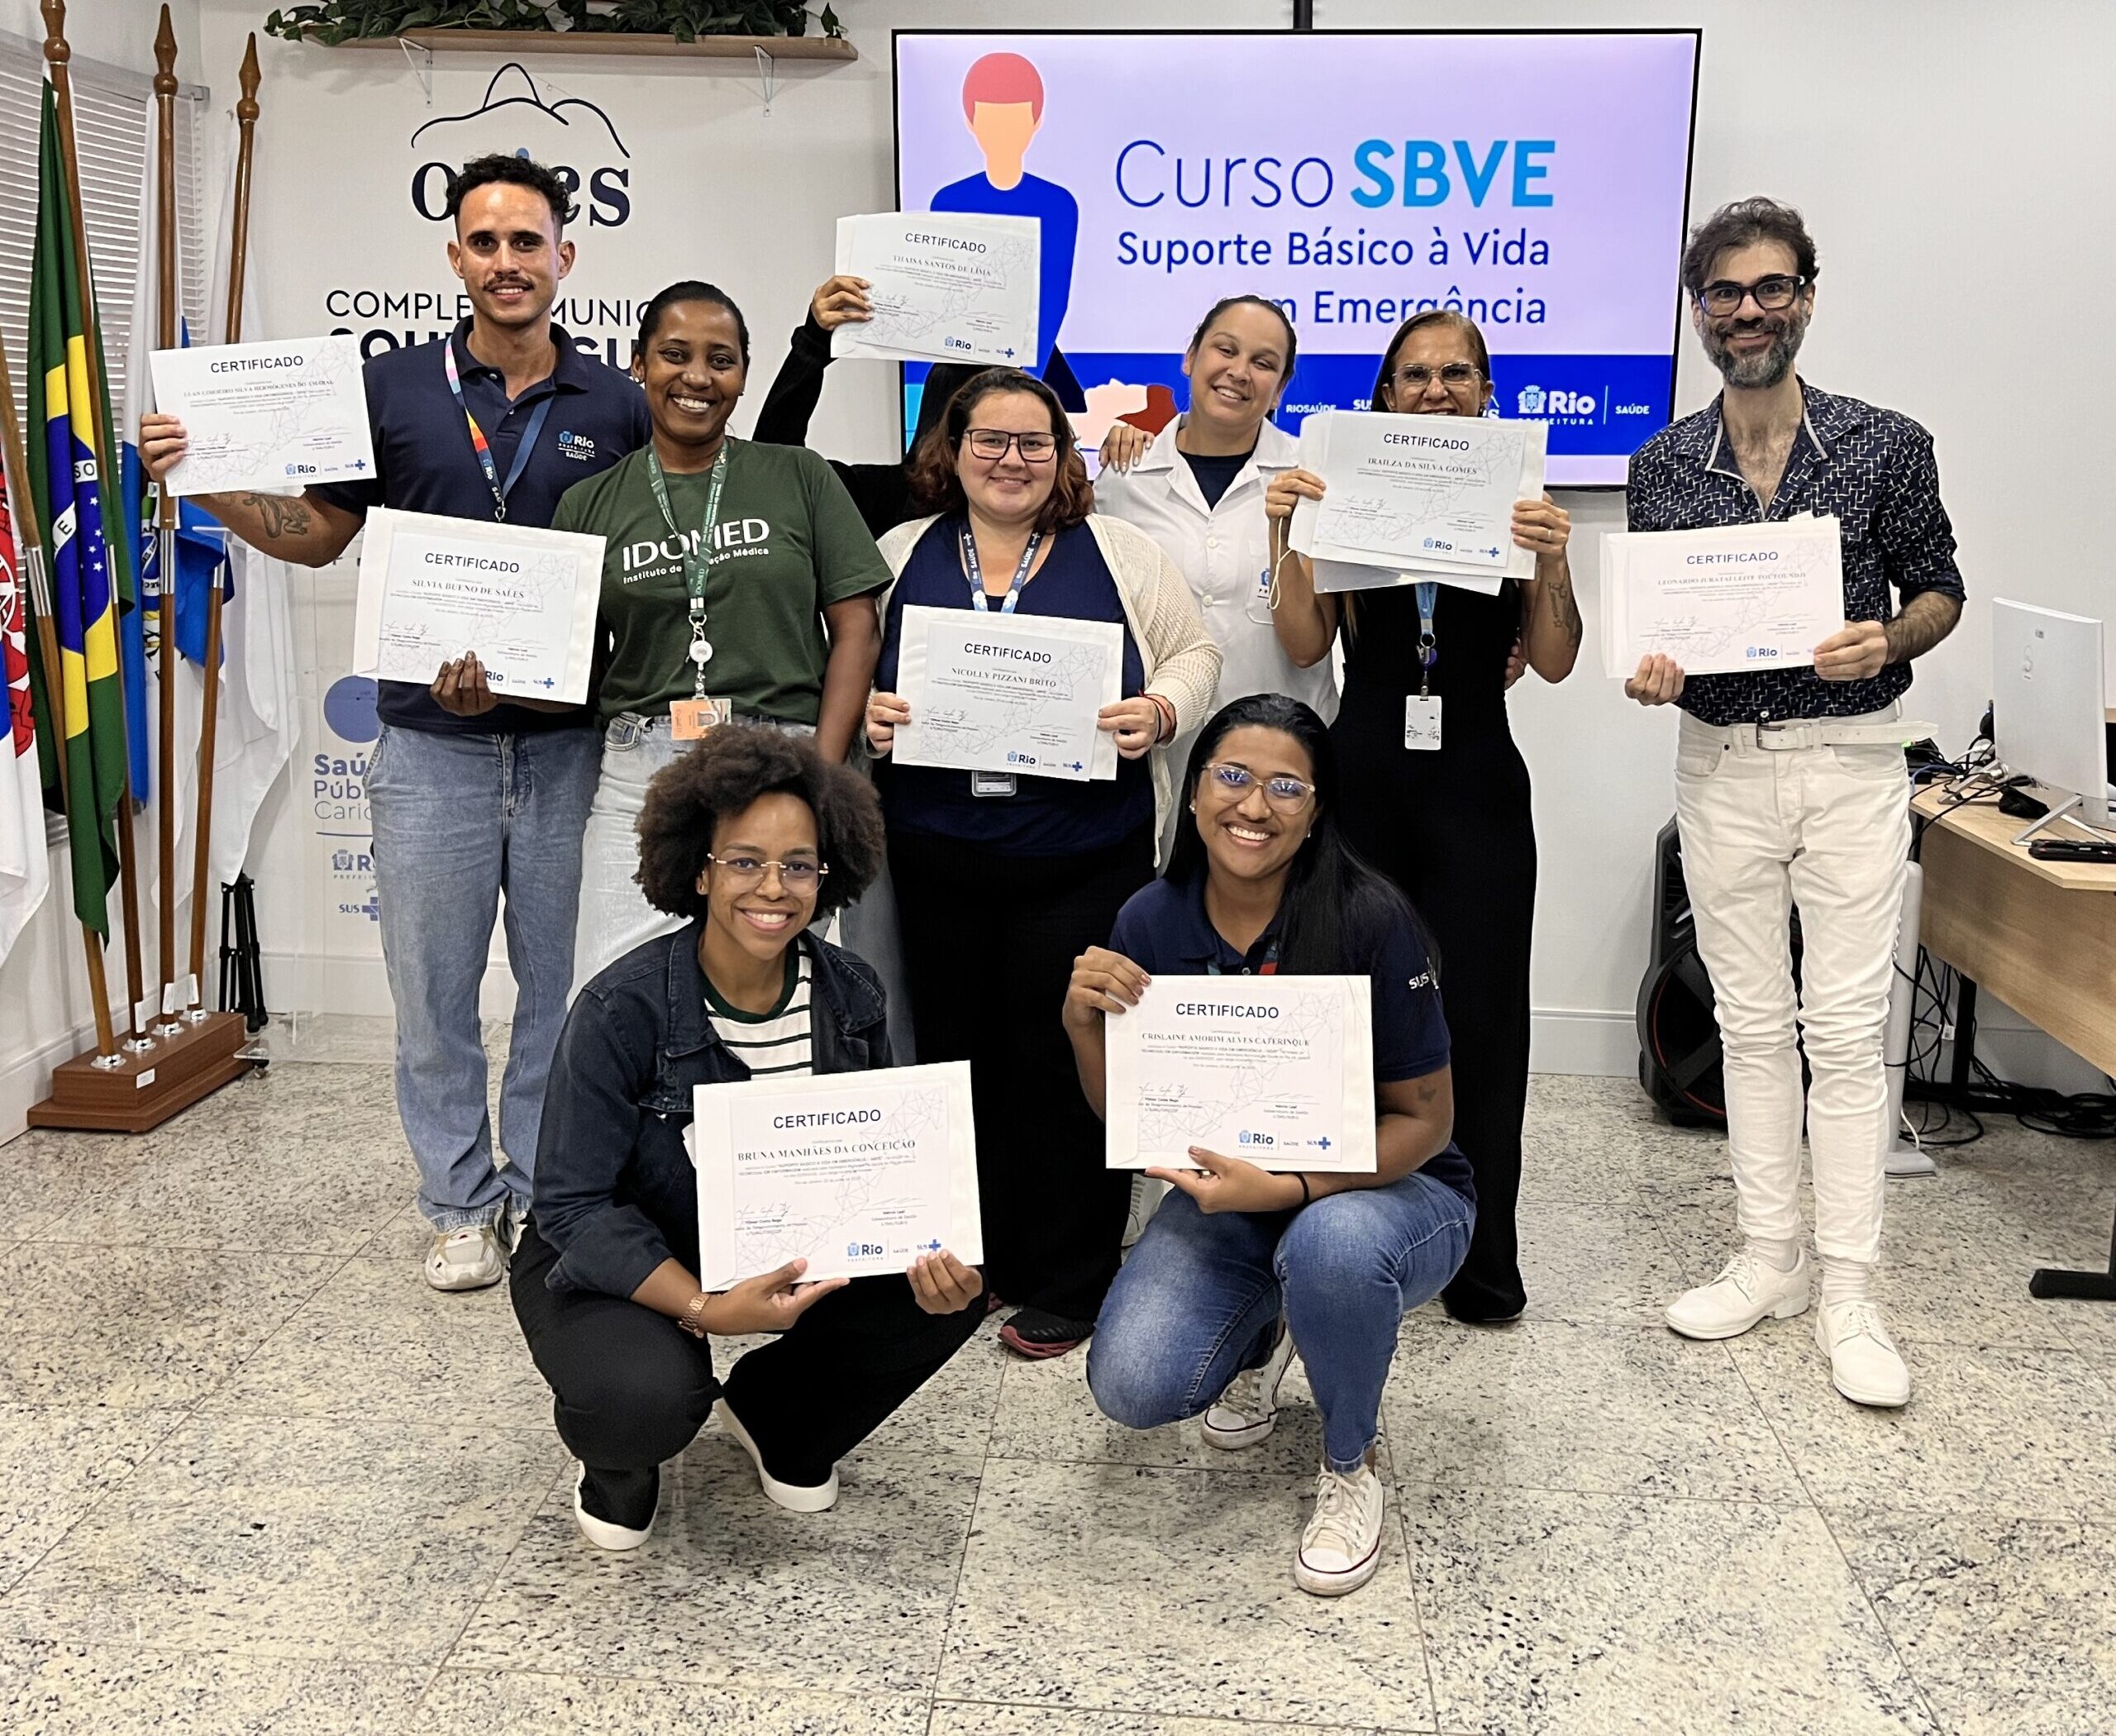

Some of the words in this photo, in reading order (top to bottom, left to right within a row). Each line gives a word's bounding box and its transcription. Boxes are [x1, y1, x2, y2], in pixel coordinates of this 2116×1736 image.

[1116, 140, 1332, 207] Curso
[1350, 139, 1556, 207] SBVE
[905, 232, 986, 254] CERTIFICADO
[1118, 231, 1272, 273] Suporte
[1288, 227, 1413, 265] Básico
[1428, 227, 1448, 265] à
[1464, 228, 1549, 265] Vida
[925, 260, 956, 270] SANTOS
[326, 289, 471, 321] COMPLE
[551, 298, 651, 327] MUNIC
[956, 340, 971, 350] Rio
[211, 355, 303, 373] CERTIFICADO
[1285, 402, 1337, 413] RIOSAÚDE
[1353, 399, 1371, 410] SU
[1546, 390, 1595, 415] Rio
[1615, 403, 1650, 415] SAÚDE
[574, 435, 594, 448] Rio
[1384, 433, 1469, 451] CERTIFICADO
[298, 465, 316, 474] Rio
[1418, 463, 1443, 471] SILVA
[1446, 465, 1477, 475] GOMES
[623, 518, 770, 572] IDOMED
[1435, 541, 1452, 551] Rio
[425, 552, 520, 573] CERTIFICADO
[1686, 551, 1778, 565] CERTIFICADO
[623, 566, 666, 584] Instituto
[670, 565, 682, 574] de
[733, 546, 770, 558] Médica
[1658, 577, 1699, 585] LEONARDO
[446, 583, 478, 594] BUENO
[480, 587, 493, 595] DE
[964, 643, 1051, 663] CERTIFICADO
[1759, 648, 1777, 657] Rio
[485, 670, 503, 681] Rio
[952, 668, 991, 678] NICOLLY
[993, 674, 1027, 684] PIZZANI
[1029, 678, 1056, 687] BRITO
[314, 753, 366, 776] Saú
[1018, 754, 1036, 764] Rio
[339, 904, 360, 913] SUS
[1408, 972, 1429, 989] SUS
[1175, 1003, 1280, 1018] CERTIFICADO
[1141, 1033, 1185, 1042] CRISLAINE
[1189, 1034, 1224, 1043] AMORIM
[1227, 1037, 1253, 1045] ALVES
[774, 1109, 881, 1129] CERTIFICADO
[1253, 1133, 1274, 1145] Rio
[738, 1151, 775, 1161] BRUNA
[779, 1145, 832, 1158] MANHÃES
[834, 1146, 848, 1154] DA
[851, 1139, 916, 1153] CONCEIÇÃO
[861, 1244, 883, 1256] Rio
